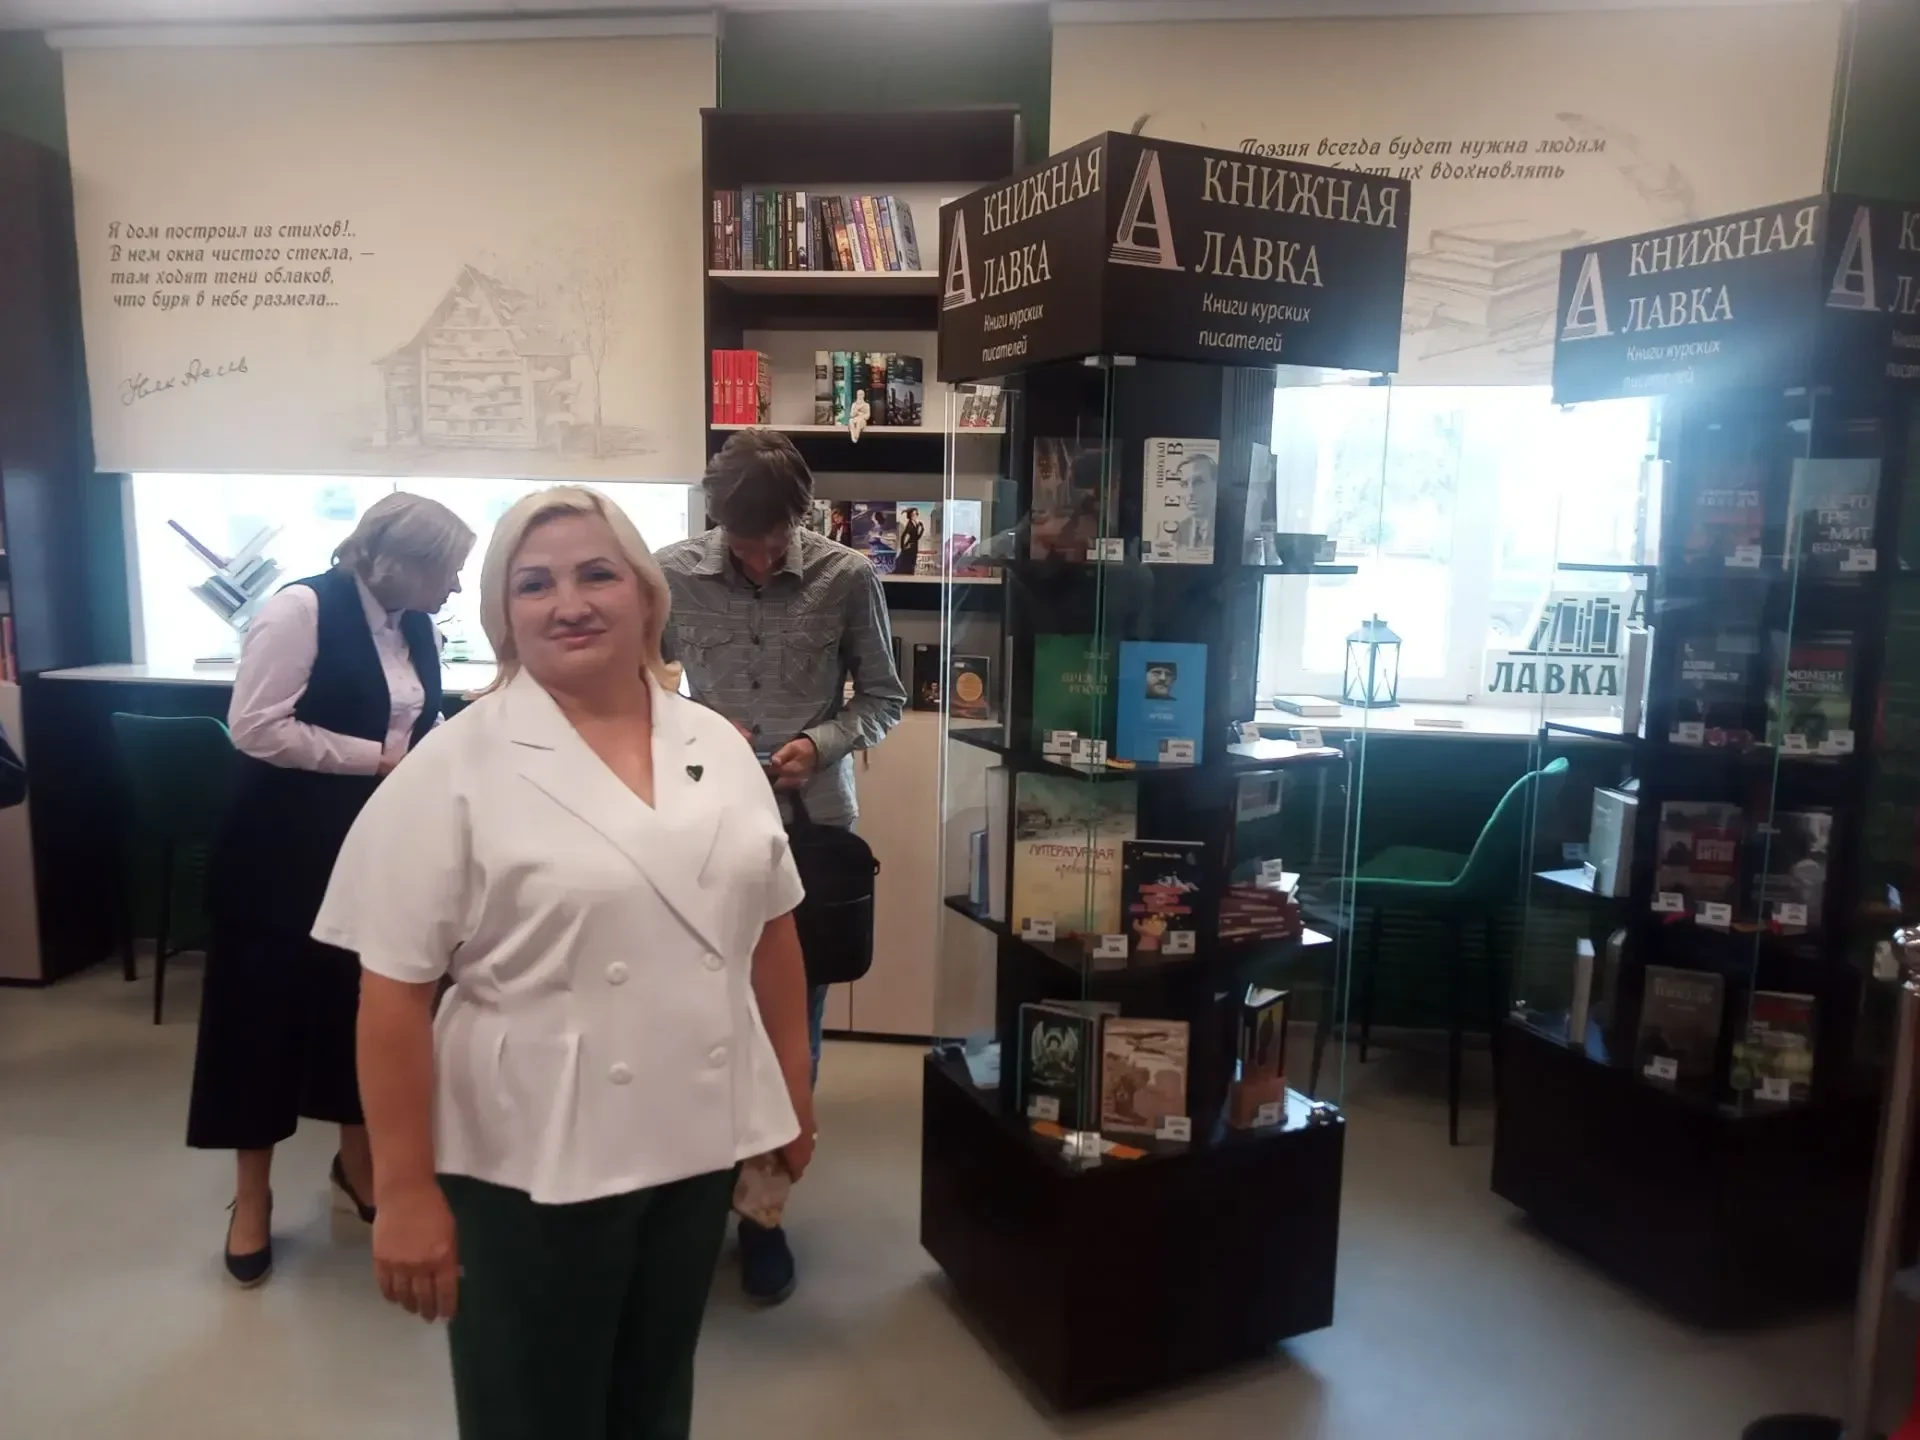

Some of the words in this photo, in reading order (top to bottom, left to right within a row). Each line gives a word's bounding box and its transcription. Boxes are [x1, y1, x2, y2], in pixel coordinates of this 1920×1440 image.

[1239, 138, 1309, 157] Поэзия
[1317, 137, 1381, 156] всегда
[1389, 135, 1452, 160] будет
[1460, 139, 1527, 157] нужна
[1535, 136, 1605, 154] людям
[1398, 165, 1424, 180] их
[1430, 160, 1565, 180] вдохновлять
[983, 147, 1102, 236] КНИЖНАЯ
[1201, 157, 1400, 229] КНИЖНАЯ
[108, 221, 121, 239] Я
[126, 223, 159, 239] дом
[165, 224, 247, 243] построил
[254, 225, 272, 238] из
[1627, 205, 1820, 278] КНИЖНАЯ
[110, 244, 122, 262] В
[128, 249, 160, 262] нем
[167, 249, 204, 262] окна
[212, 248, 280, 261] чистого
[286, 247, 353, 263] стекла,
[1195, 231, 1324, 288] ЛАВКА
[111, 270, 149, 284] там
[156, 269, 207, 284] ходят
[214, 270, 257, 284] тени
[980, 240, 1052, 300] ЛАВКА
[113, 293, 146, 306] что
[153, 290, 190, 311] буря
[196, 291, 205, 306] в
[212, 290, 248, 306] небе
[253, 293, 339, 310] размела...
[1203, 292, 1248, 317] Книги
[1251, 301, 1311, 324] курских
[1621, 284, 1734, 334] ЛАВКА
[984, 313, 1008, 332] Книги
[1009, 304, 1044, 330] курских
[982, 335, 1028, 362] писателей
[1199, 329, 1282, 353] писателей
[1163, 442, 1183, 534] СЕЕВ
[1488, 662, 1617, 696] ЛАВКА
